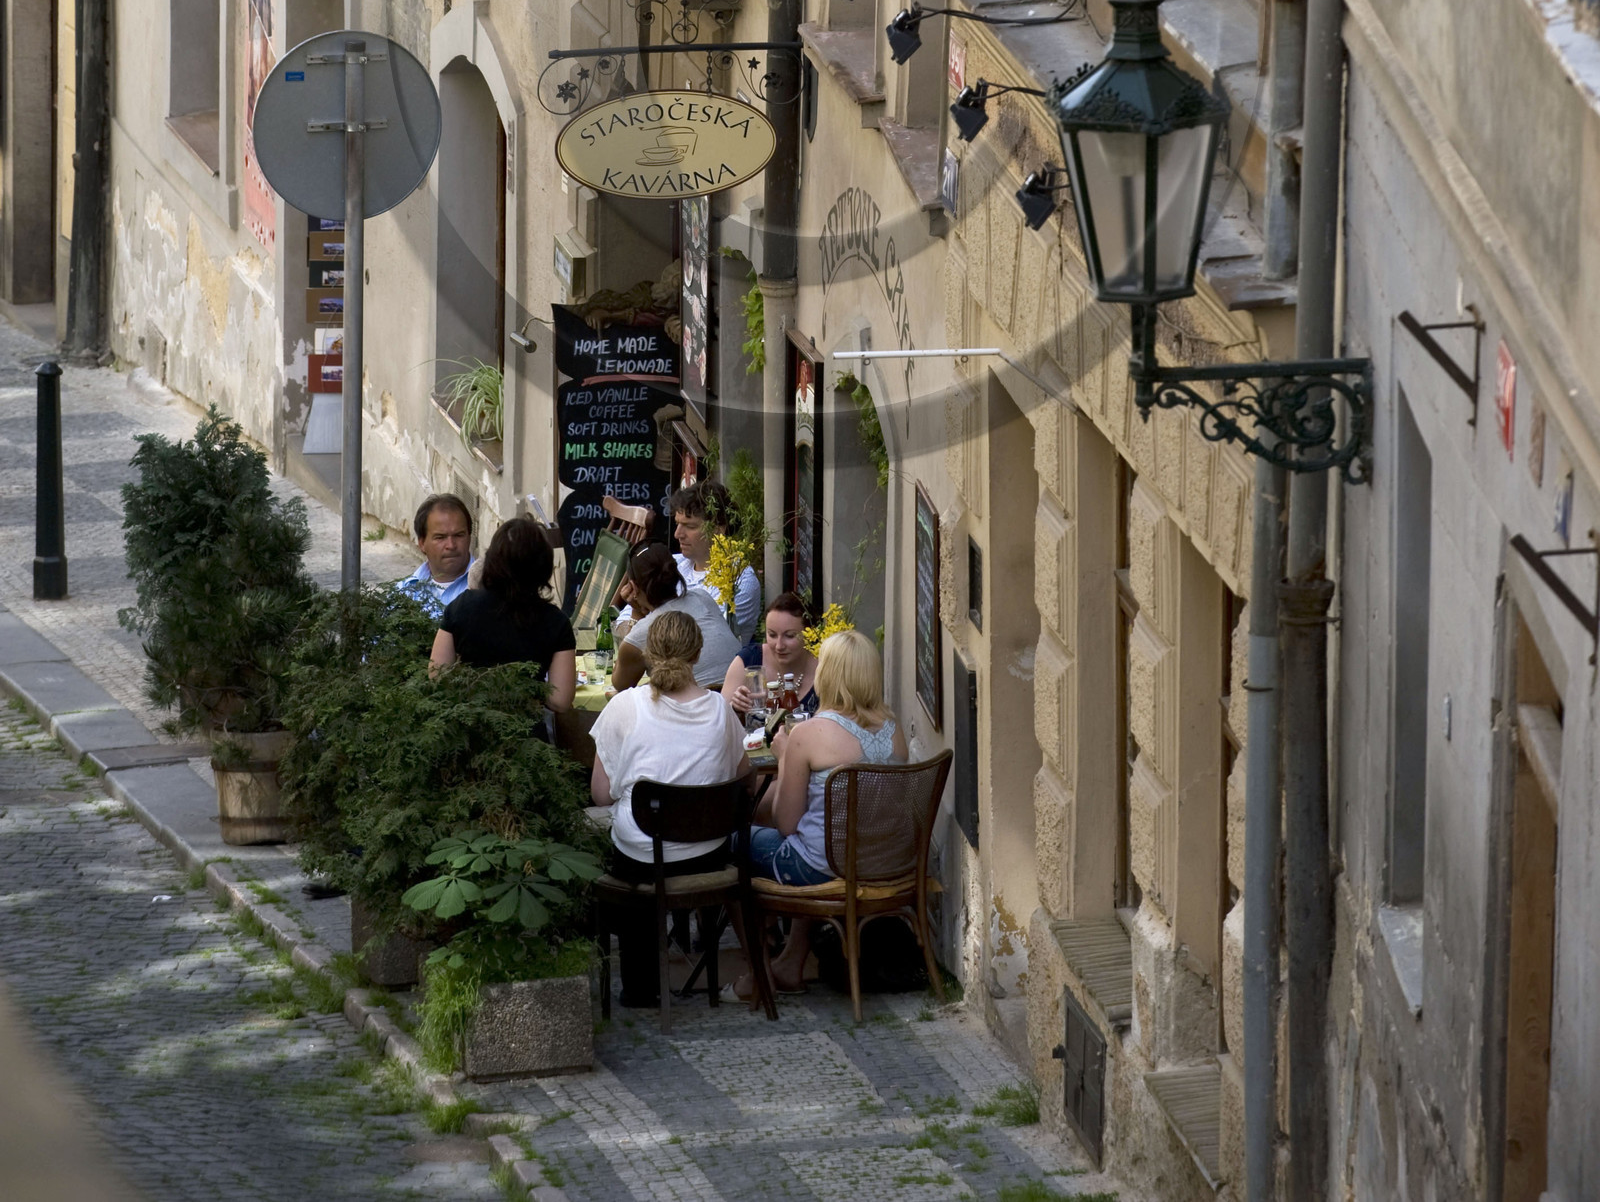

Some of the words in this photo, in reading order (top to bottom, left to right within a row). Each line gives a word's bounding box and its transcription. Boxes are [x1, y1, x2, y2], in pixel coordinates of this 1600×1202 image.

[580, 97, 755, 146] STAROČESKÁ
[602, 163, 737, 194] KAVÁRNA
[818, 187, 881, 296] ANTIQUE
[574, 339, 611, 356] HOME
[617, 336, 658, 354] MADE
[596, 358, 673, 374] LEMONADE
[565, 390, 593, 406] ICED
[597, 386, 648, 403] VANILLE
[588, 403, 636, 419] COFFEE
[567, 421, 598, 436] SOFT
[600, 419, 650, 436] DRINKS
[565, 442, 599, 460] MILK
[602, 442, 653, 459] SHAKES
[573, 466, 622, 483] DRAFT
[602, 483, 650, 499] BEERS
[570, 528, 599, 547] GIN
